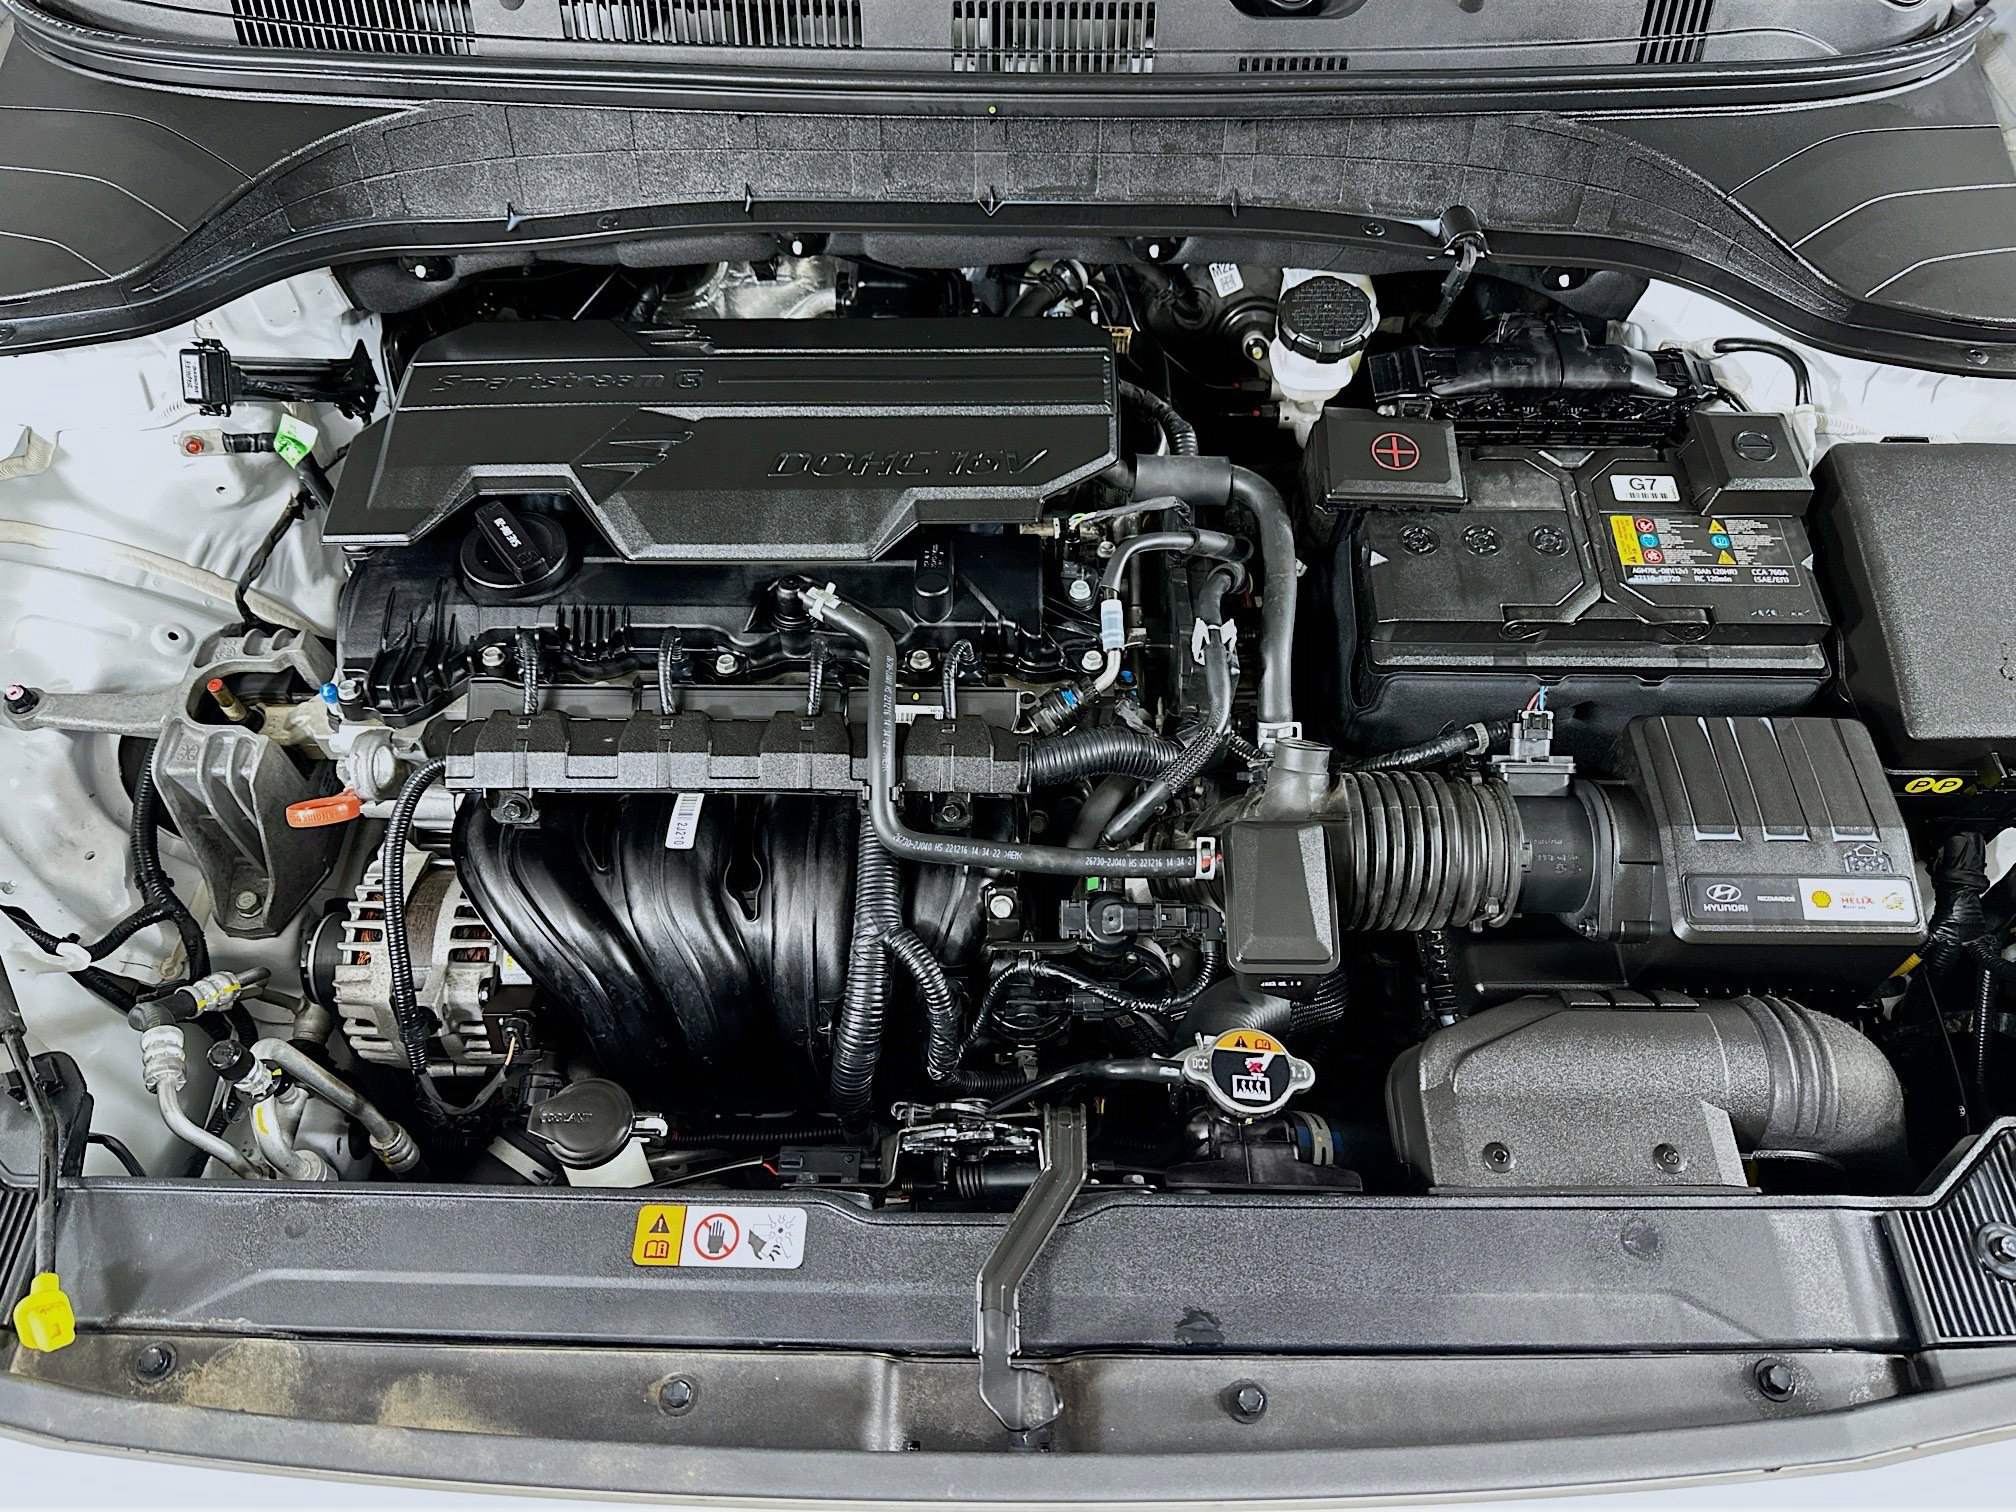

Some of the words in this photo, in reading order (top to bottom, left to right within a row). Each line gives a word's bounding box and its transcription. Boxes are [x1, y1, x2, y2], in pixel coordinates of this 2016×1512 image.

[430, 371, 665, 393] Smartstream
[676, 370, 702, 390] G
[767, 450, 939, 476] DOHC
[949, 449, 1048, 475] 16V
[1629, 477, 1657, 490] G7
[1751, 568, 1768, 576] CCA
[934, 843, 943, 852] HS
[945, 844, 967, 855] 221216
[1085, 856, 1126, 867] 26730-2J040
[1128, 858, 1137, 867] HS
[1140, 858, 1162, 868] 221216
[1841, 896, 1873, 904] HELIX
[1703, 903, 1748, 912] HYUNDAI
[1192, 1057, 1208, 1070] DCC
[1291, 1066, 1307, 1079] 1.1
[540, 1108, 593, 1123] COOLANT
